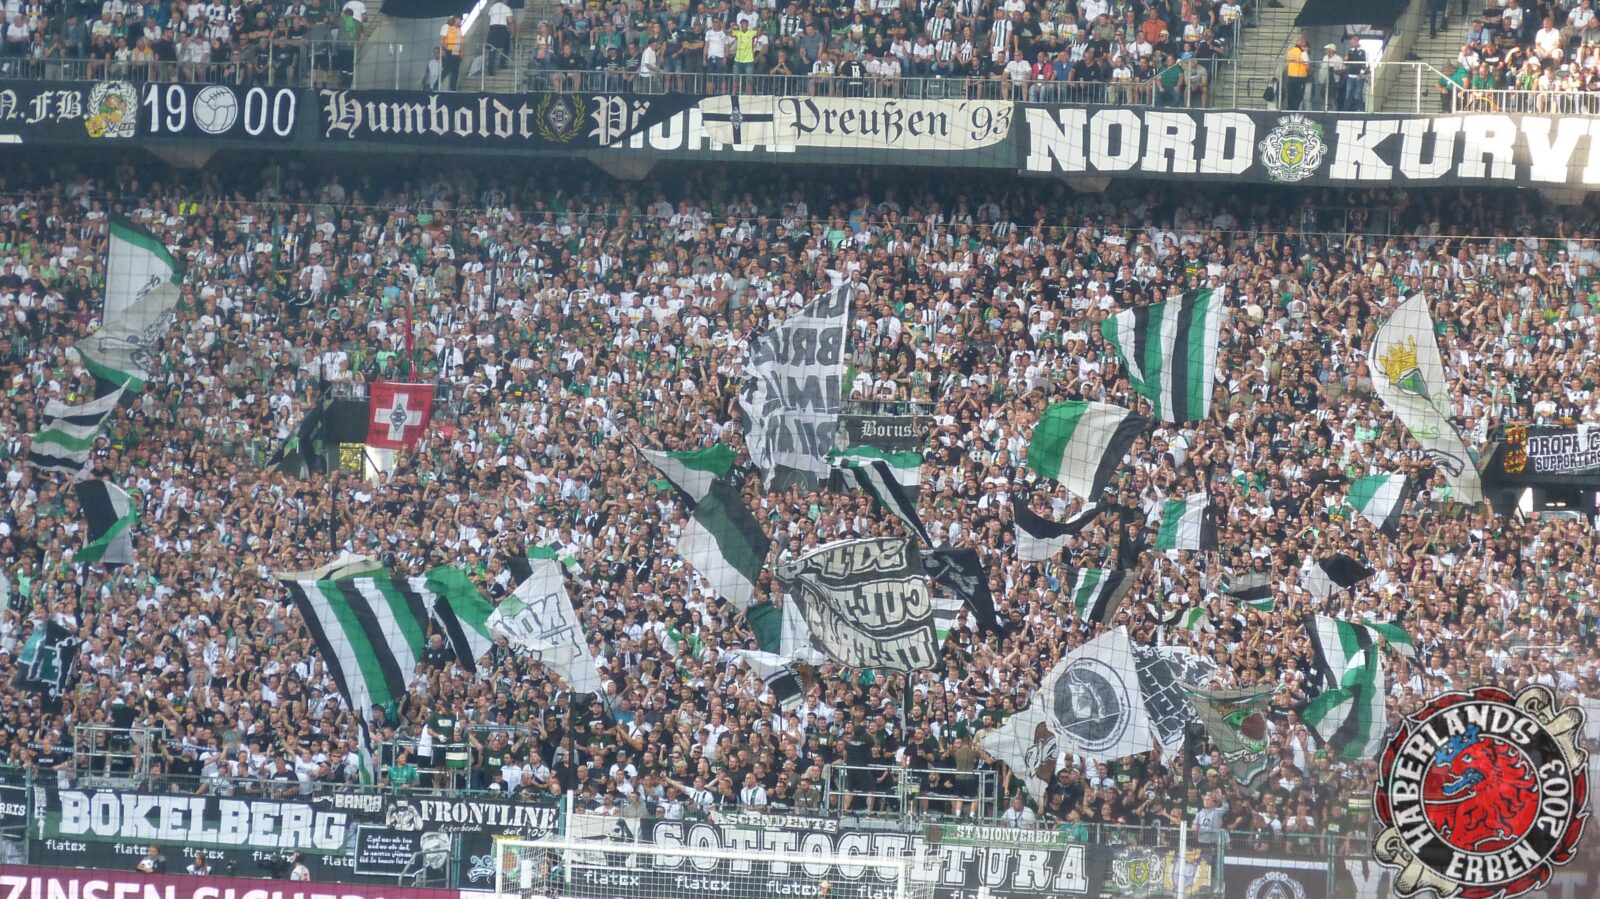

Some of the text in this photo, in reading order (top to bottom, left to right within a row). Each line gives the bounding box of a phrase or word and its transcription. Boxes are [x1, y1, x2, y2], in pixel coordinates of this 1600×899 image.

[144, 84, 296, 136] 19 00
[320, 88, 533, 138] Humboldt
[778, 97, 949, 144] Preußen
[1024, 107, 1256, 174] NORD
[335, 794, 382, 809] BANDA
[419, 799, 560, 829] FRONTLINE
[711, 810, 839, 833] ASCENDENTE
[45, 839, 86, 852] flatex
[956, 824, 1060, 845] STADIONVERBOT
[113, 843, 149, 855] flate
[653, 820, 1089, 894] SOTTOCULTURA
[583, 870, 640, 887] flatex
[675, 875, 731, 892] flatex
